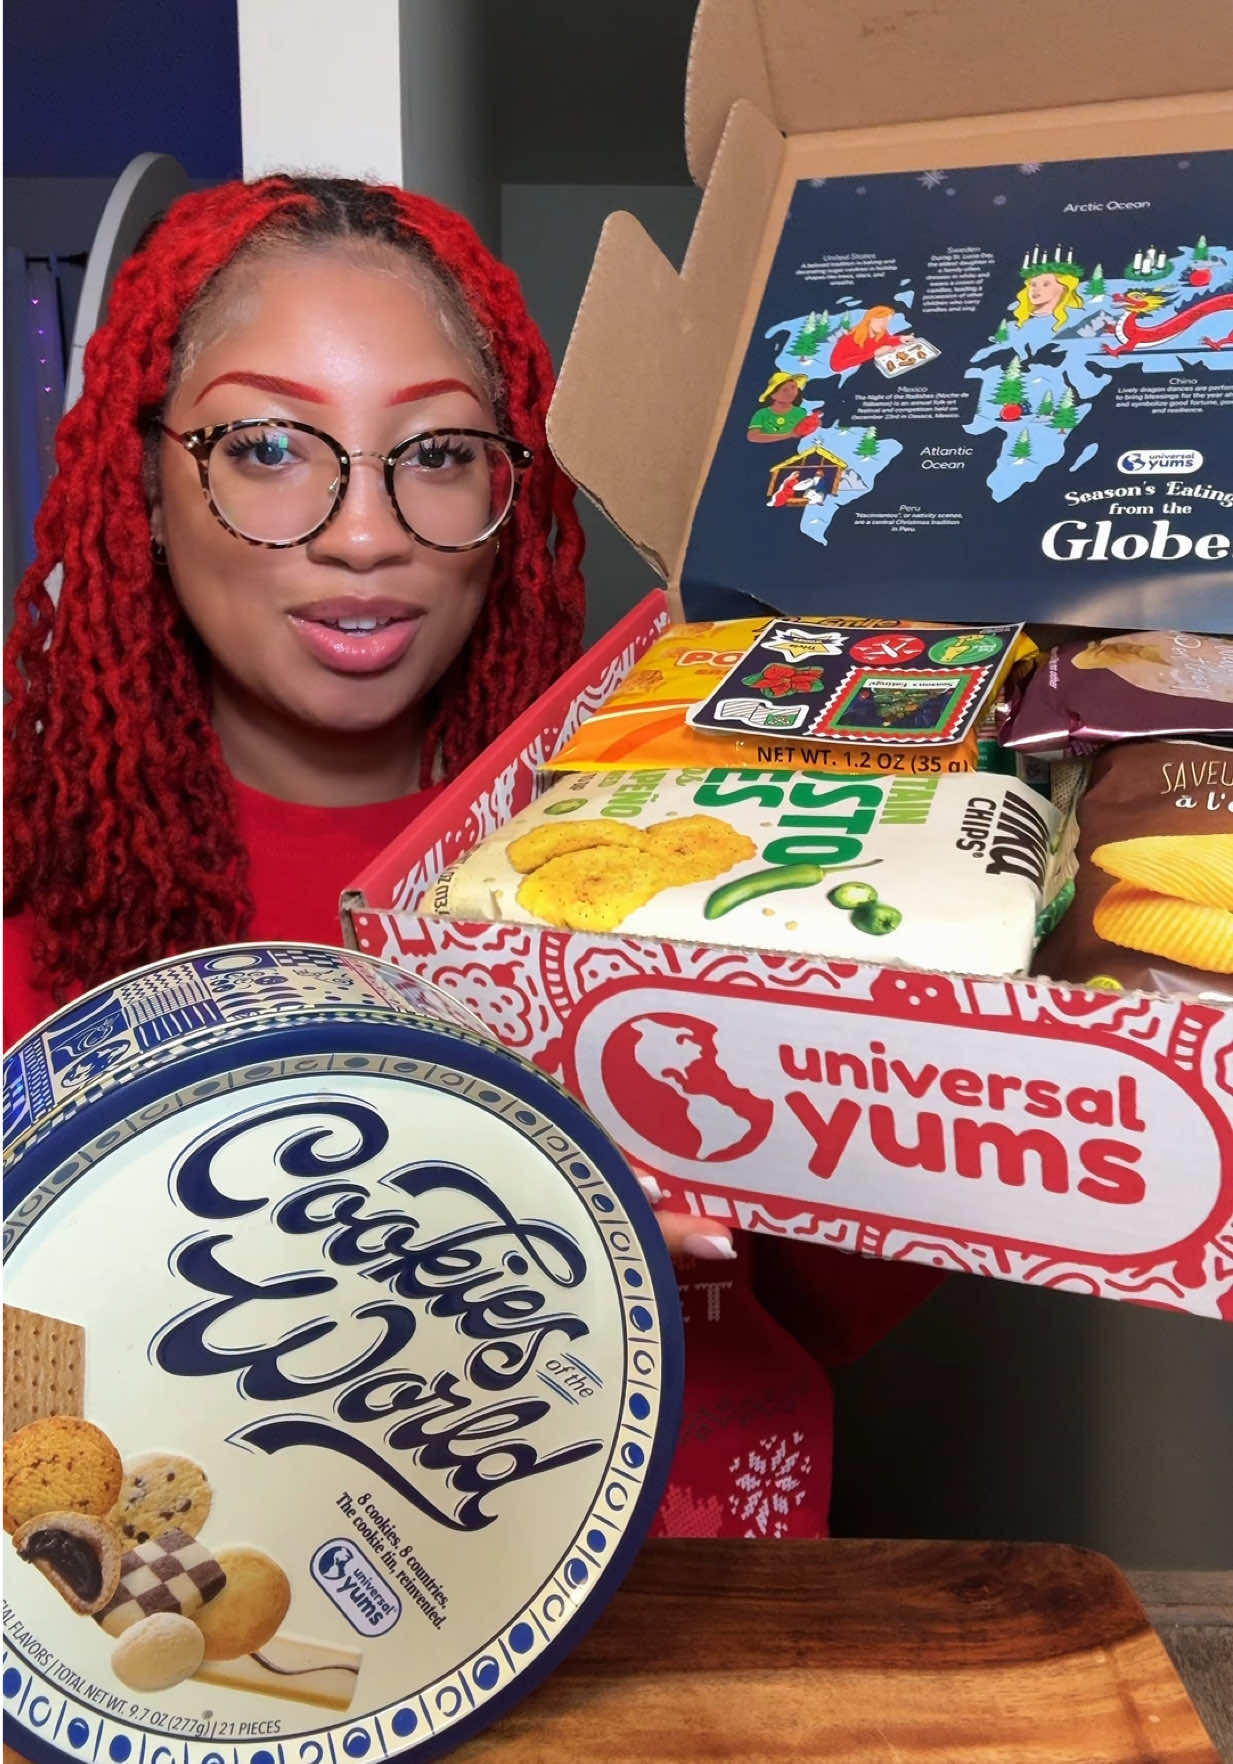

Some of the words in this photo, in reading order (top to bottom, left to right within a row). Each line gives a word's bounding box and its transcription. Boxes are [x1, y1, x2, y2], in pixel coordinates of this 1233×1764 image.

[1064, 202, 1103, 212] Arctic
[1106, 200, 1151, 210] Ocean
[920, 446, 974, 456] Atlantic
[921, 460, 965, 469] Ocean
[1150, 459, 1194, 470] yums
[899, 504, 921, 512] Peru
[1064, 480, 1156, 506] Season's
[1108, 502, 1154, 515] from
[1162, 502, 1192, 514] the
[1041, 519, 1230, 561] Globe
[757, 747, 796, 763] NET
[801, 749, 836, 766] WT.
[844, 751, 871, 769] 1.2
[877, 753, 904, 771] OZ
[911, 754, 941, 774] (35
[762, 773, 886, 865] STO
[879, 776, 940, 825] TAIN
[778, 1040, 1146, 1133] universal
[784, 1088, 1147, 1205] yums
[167, 1092, 591, 1392] Cookies
[147, 1229, 604, 1532] World
[545, 1357, 569, 1383] of
[564, 1371, 595, 1399] the
[357, 1493, 372, 1505] 8
[365, 1503, 401, 1549] cookies.
[399, 1545, 414, 1557] 8
[336, 1492, 357, 1519] The
[353, 1516, 385, 1554] cookie
[381, 1550, 397, 1574] tin,
[396, 1570, 447, 1630] reinvented.
[336, 1576, 384, 1626] yums
[353, 1568, 394, 1615] universal
[8, 1620, 54, 1667] FLAVORS
[53, 1664, 84, 1693] TOTAL
[85, 1685, 107, 1705] NET
[108, 1697, 127, 1715] WT.
[130, 1705, 150, 1720] 9.7
[150, 1710, 170, 1725] OZ
[167, 1715, 210, 1738] (277g)
[219, 1722, 235, 1736] 21
[239, 1720, 281, 1735] PIECES
